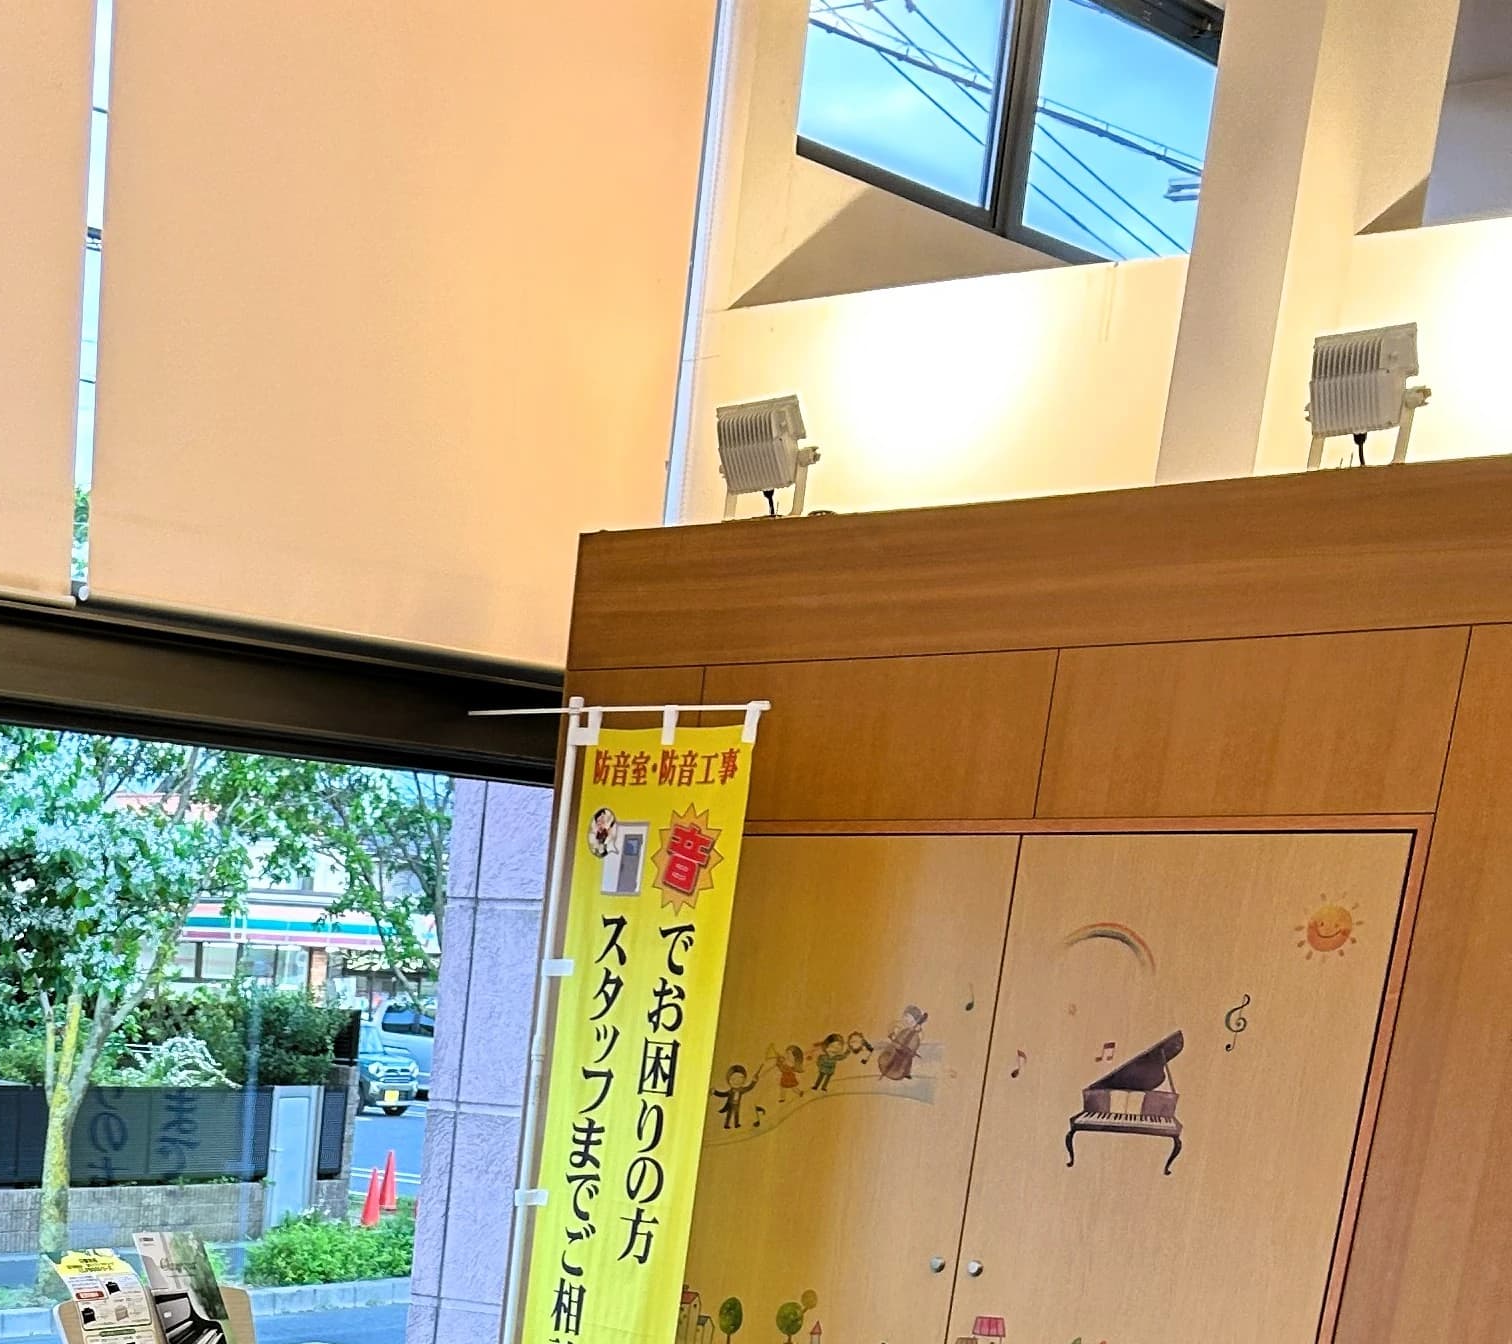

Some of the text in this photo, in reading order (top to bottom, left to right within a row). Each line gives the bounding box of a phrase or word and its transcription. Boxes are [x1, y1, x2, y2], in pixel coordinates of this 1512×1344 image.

[593, 748, 740, 787] 防音室・防音工事
[616, 822, 714, 1265] 音 でお困りの方
